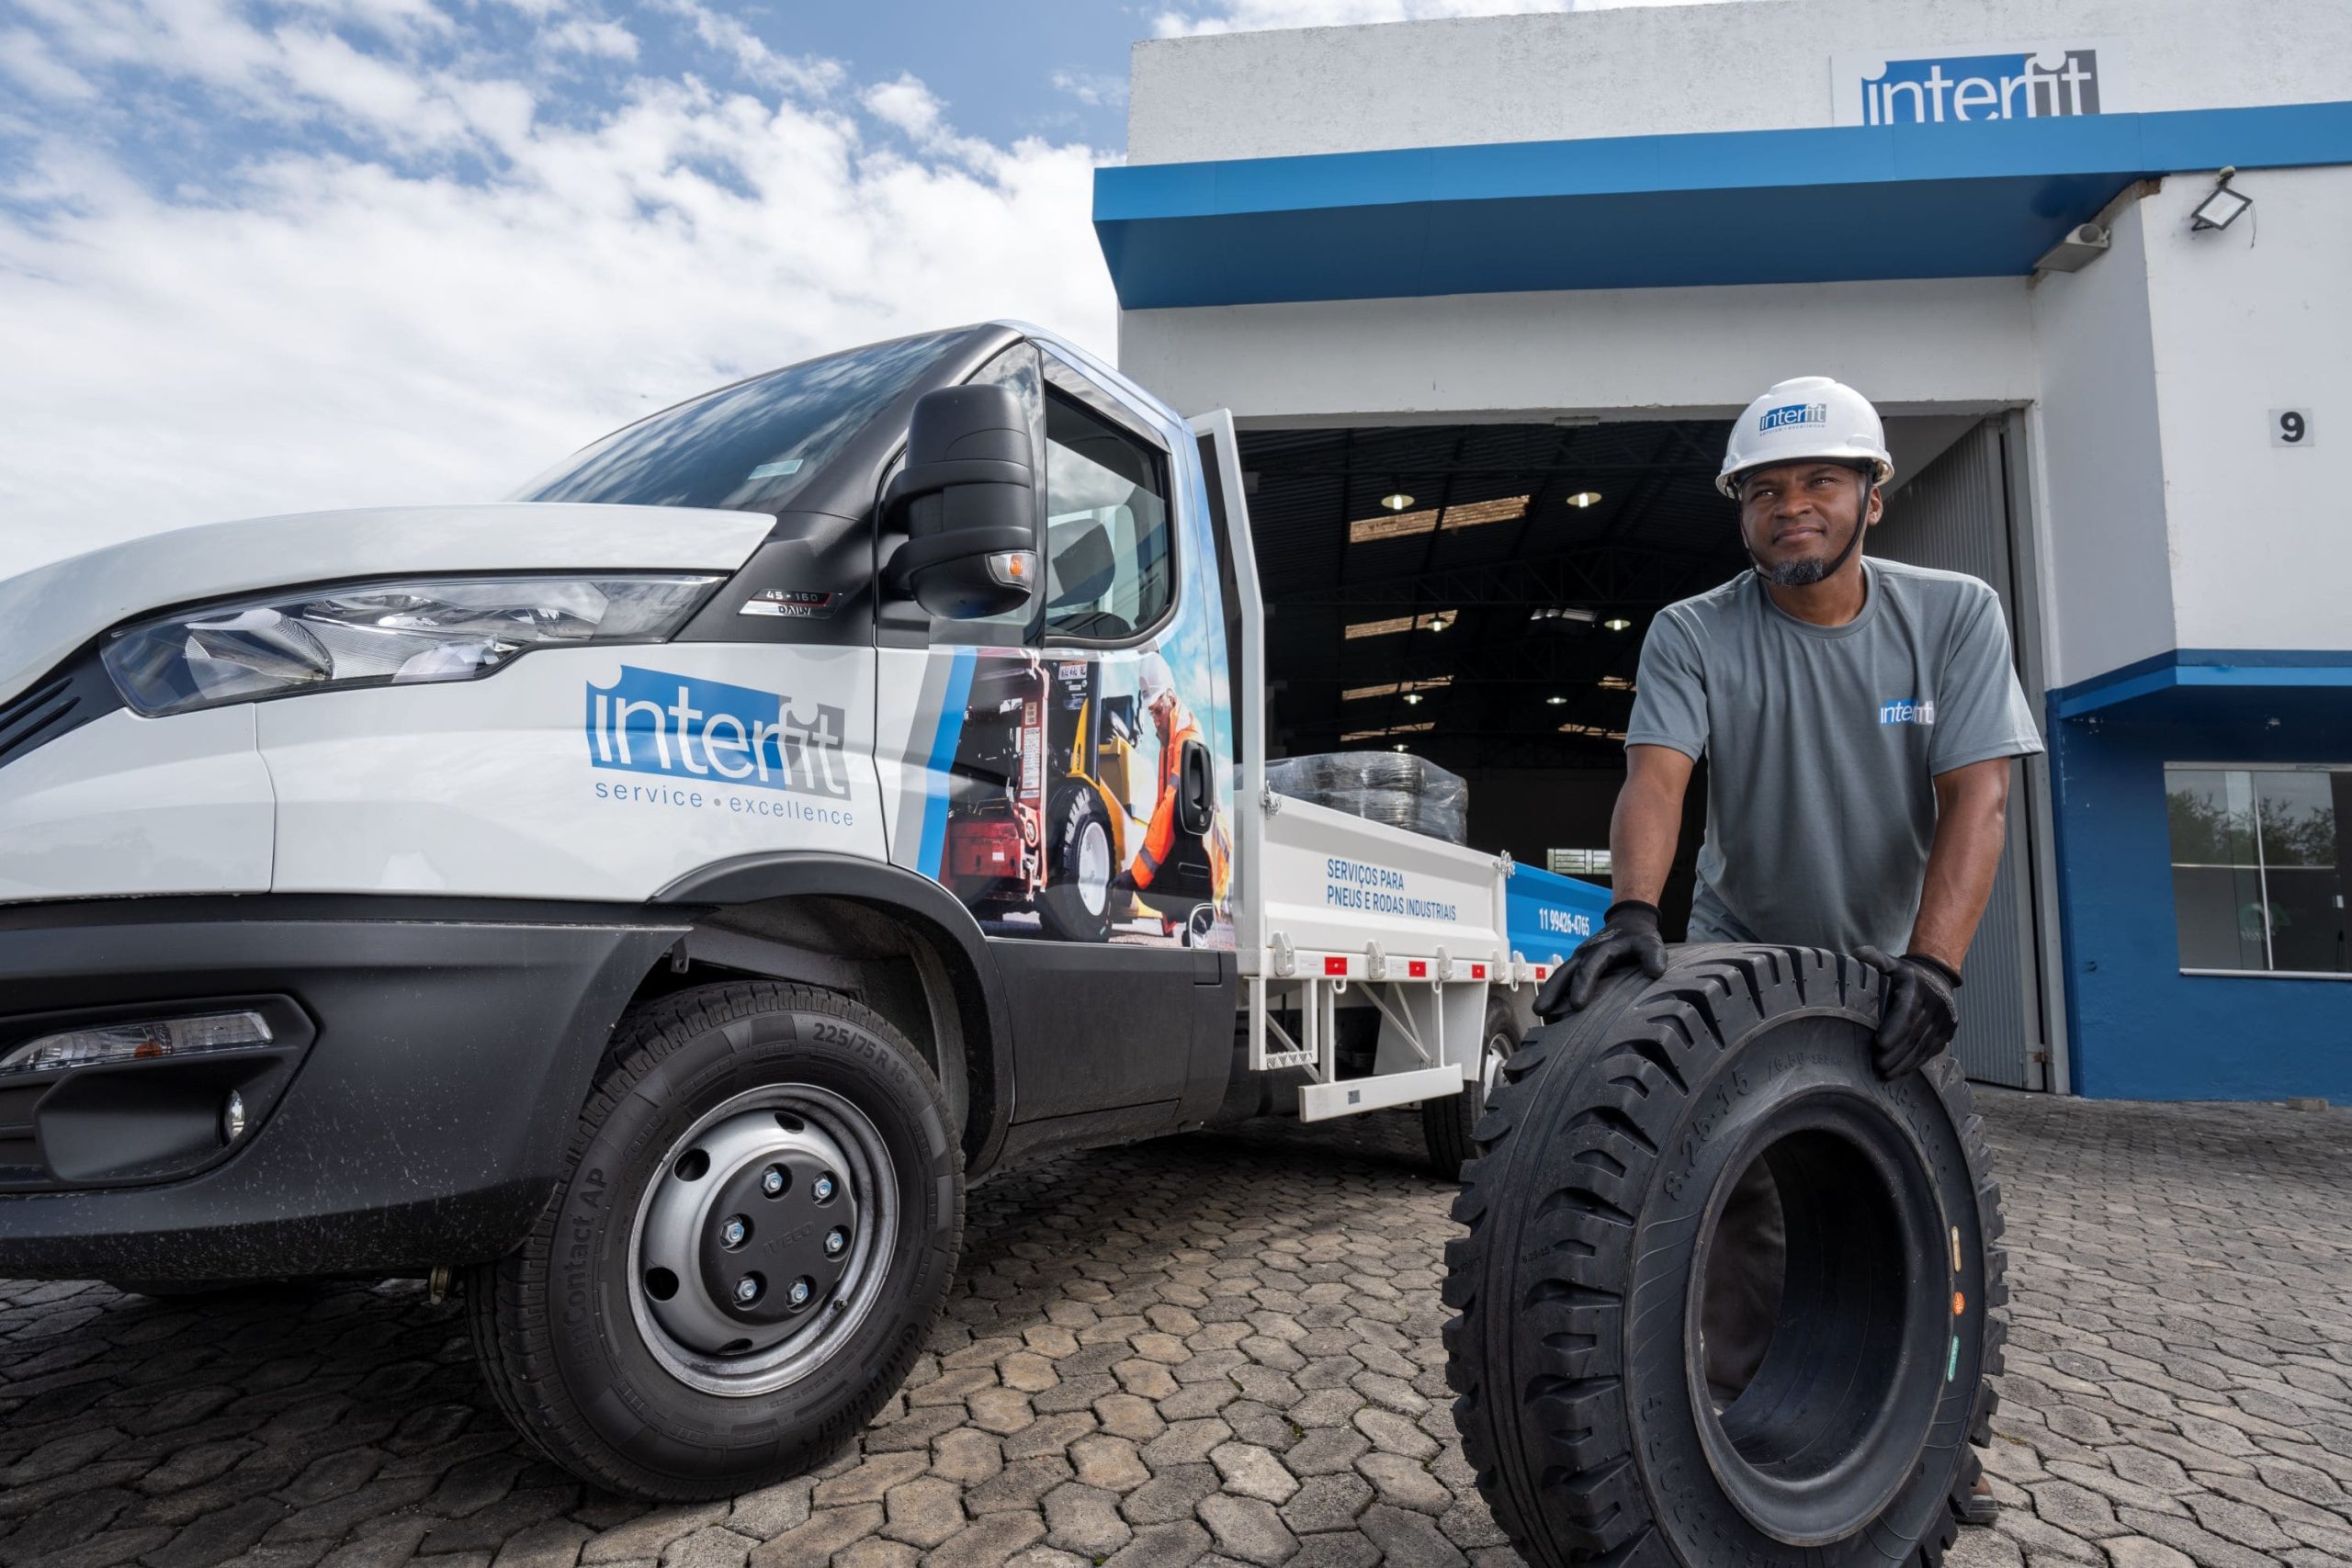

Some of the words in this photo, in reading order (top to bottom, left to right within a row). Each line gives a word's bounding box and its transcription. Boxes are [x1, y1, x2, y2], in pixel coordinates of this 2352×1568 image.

[1861, 49, 2100, 126] interfit
[1759, 404, 1826, 431] interfit
[2280, 412, 2304, 443] 9
[1879, 699, 1934, 725] interfit
[586, 665, 850, 799] interfit
[595, 783, 703, 807] service
[729, 795, 854, 827] excellence
[1327, 858, 1378, 889] SERVIÇOS
[1380, 870, 1405, 892] PARA
[1327, 885, 1363, 908] PNEUS
[1364, 894, 1371, 910] E
[1373, 895, 1405, 915] RODAS
[1406, 900, 1457, 921] INDUSTRIAIS
[1539, 908, 1548, 931] 11
[813, 1022, 877, 1059] 225/75
